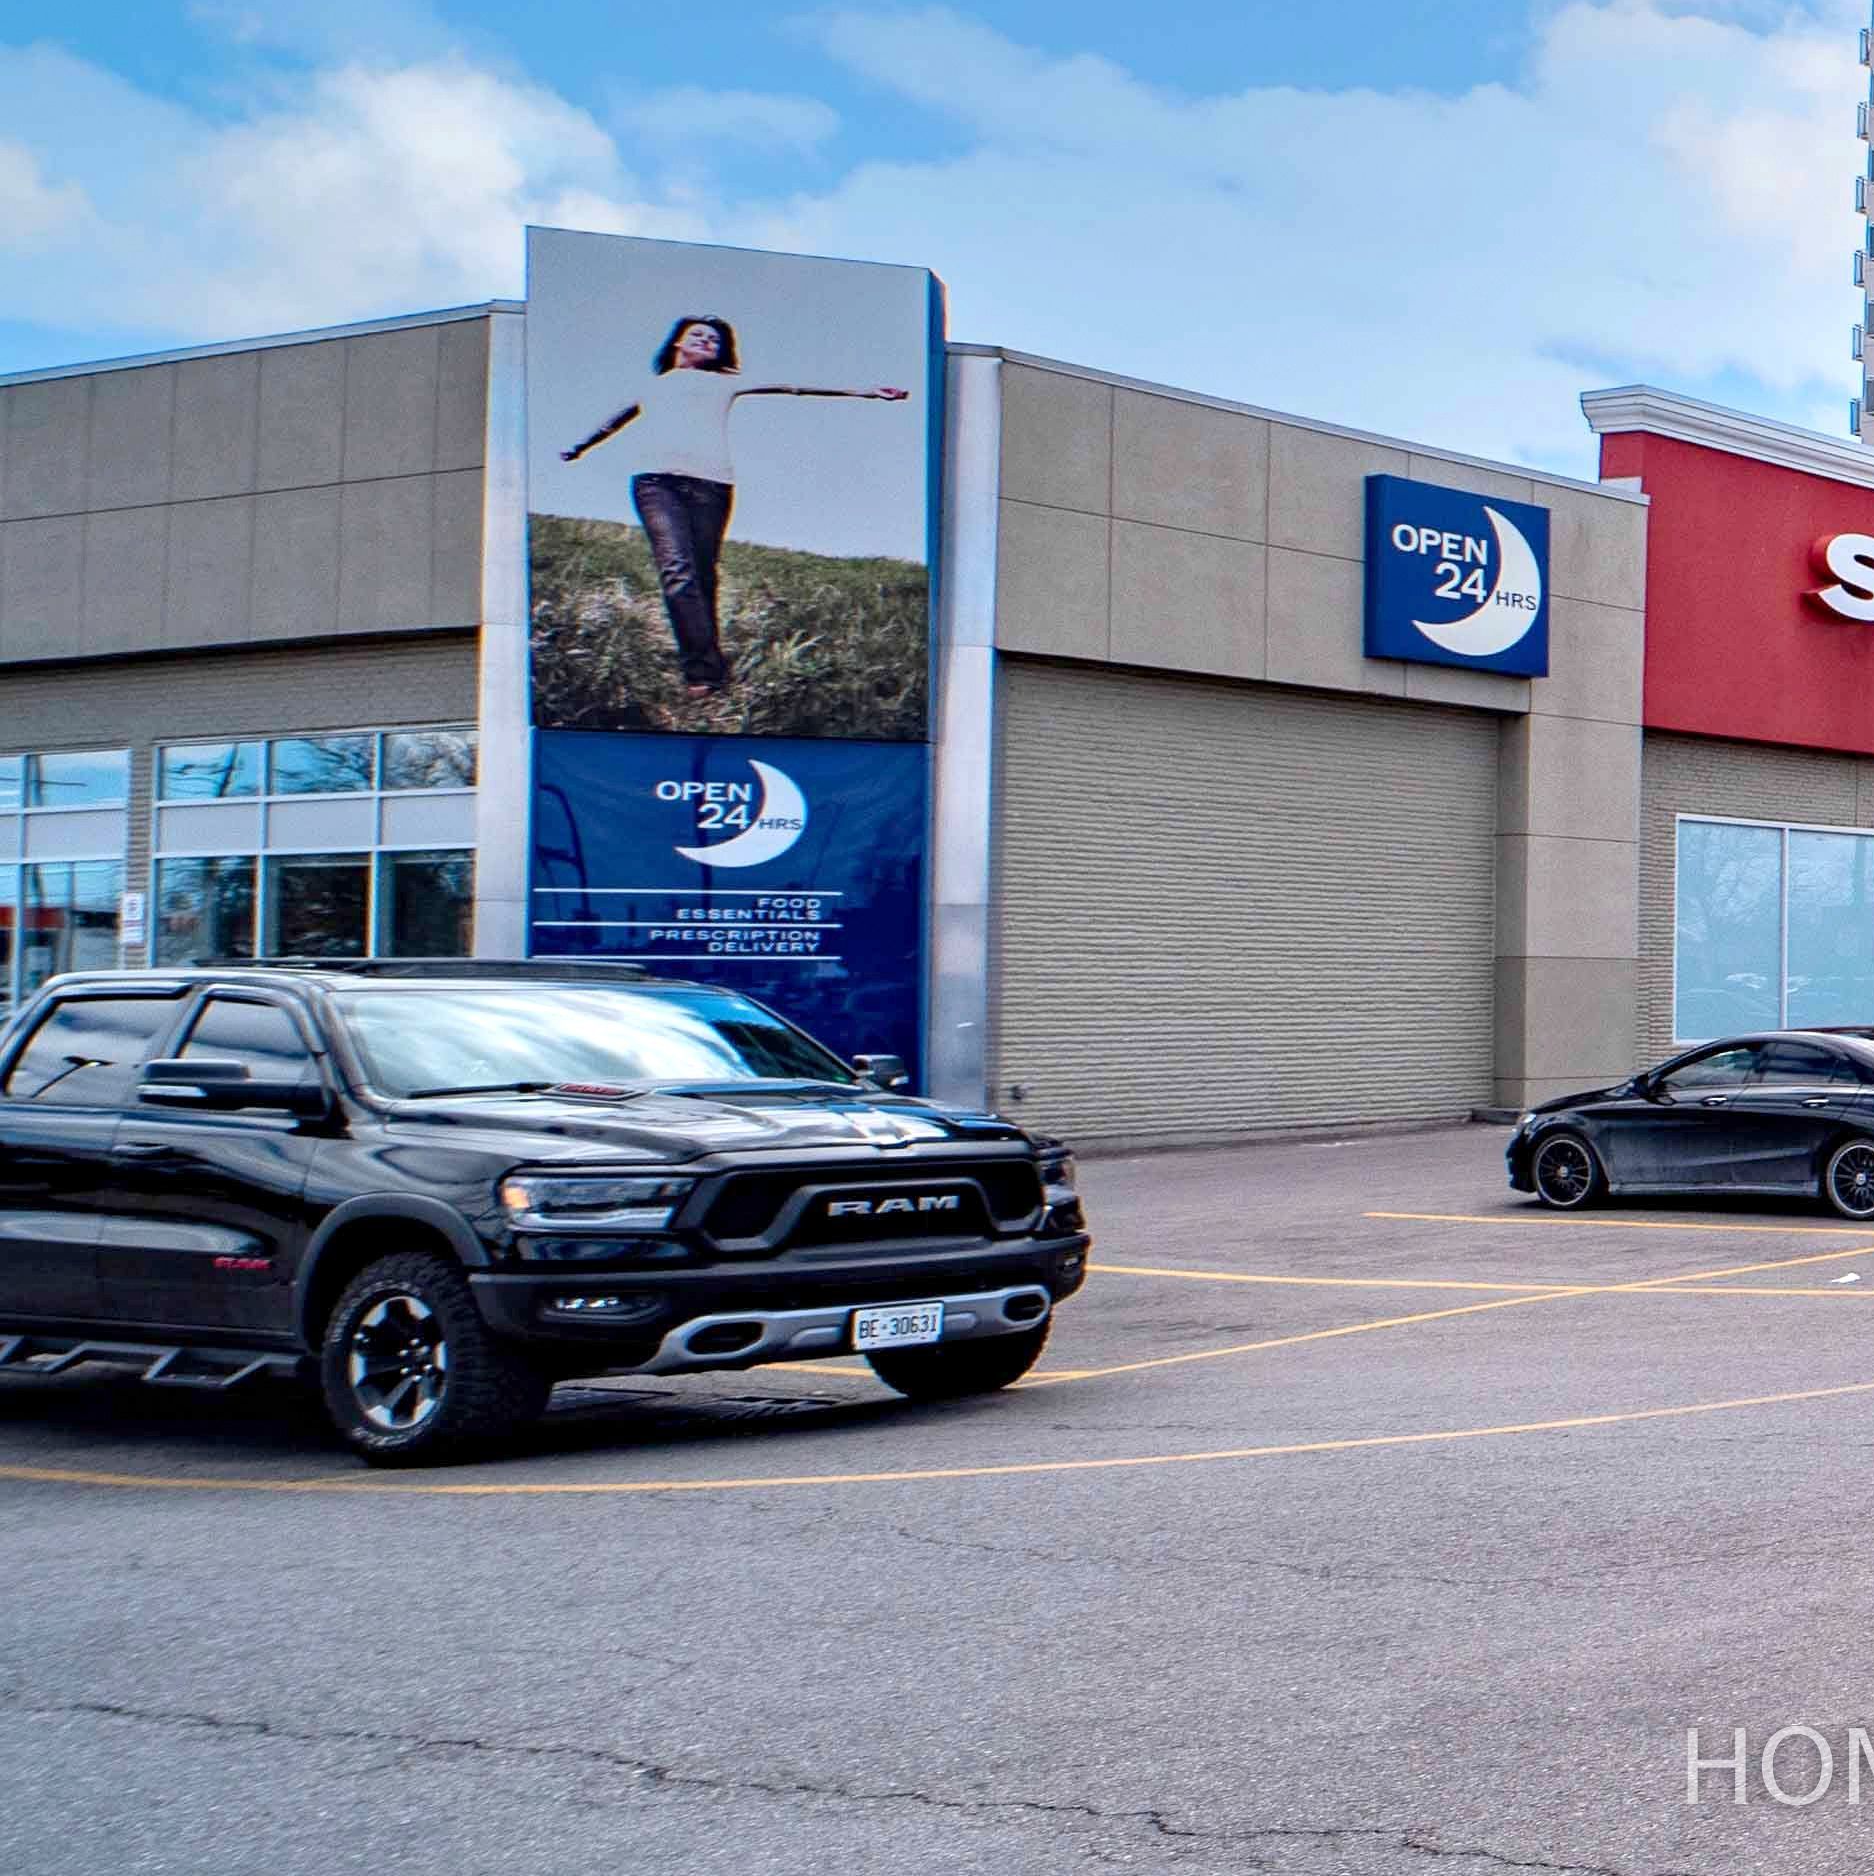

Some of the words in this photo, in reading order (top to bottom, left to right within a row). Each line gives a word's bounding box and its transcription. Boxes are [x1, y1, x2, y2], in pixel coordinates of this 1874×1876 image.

[1392, 524, 1487, 565] OPEN
[1435, 562, 1487, 604] 24
[1496, 591, 1537, 611] HRS
[656, 780, 752, 802] OPEN
[697, 802, 751, 829] 24
[758, 818, 803, 831] HRS
[756, 897, 822, 909] FOOD
[676, 909, 822, 921] ESSENTIALS
[650, 929, 821, 941] PRESCRIPTION
[708, 941, 820, 953] DELIVERY
[827, 1195, 960, 1217] RAM
